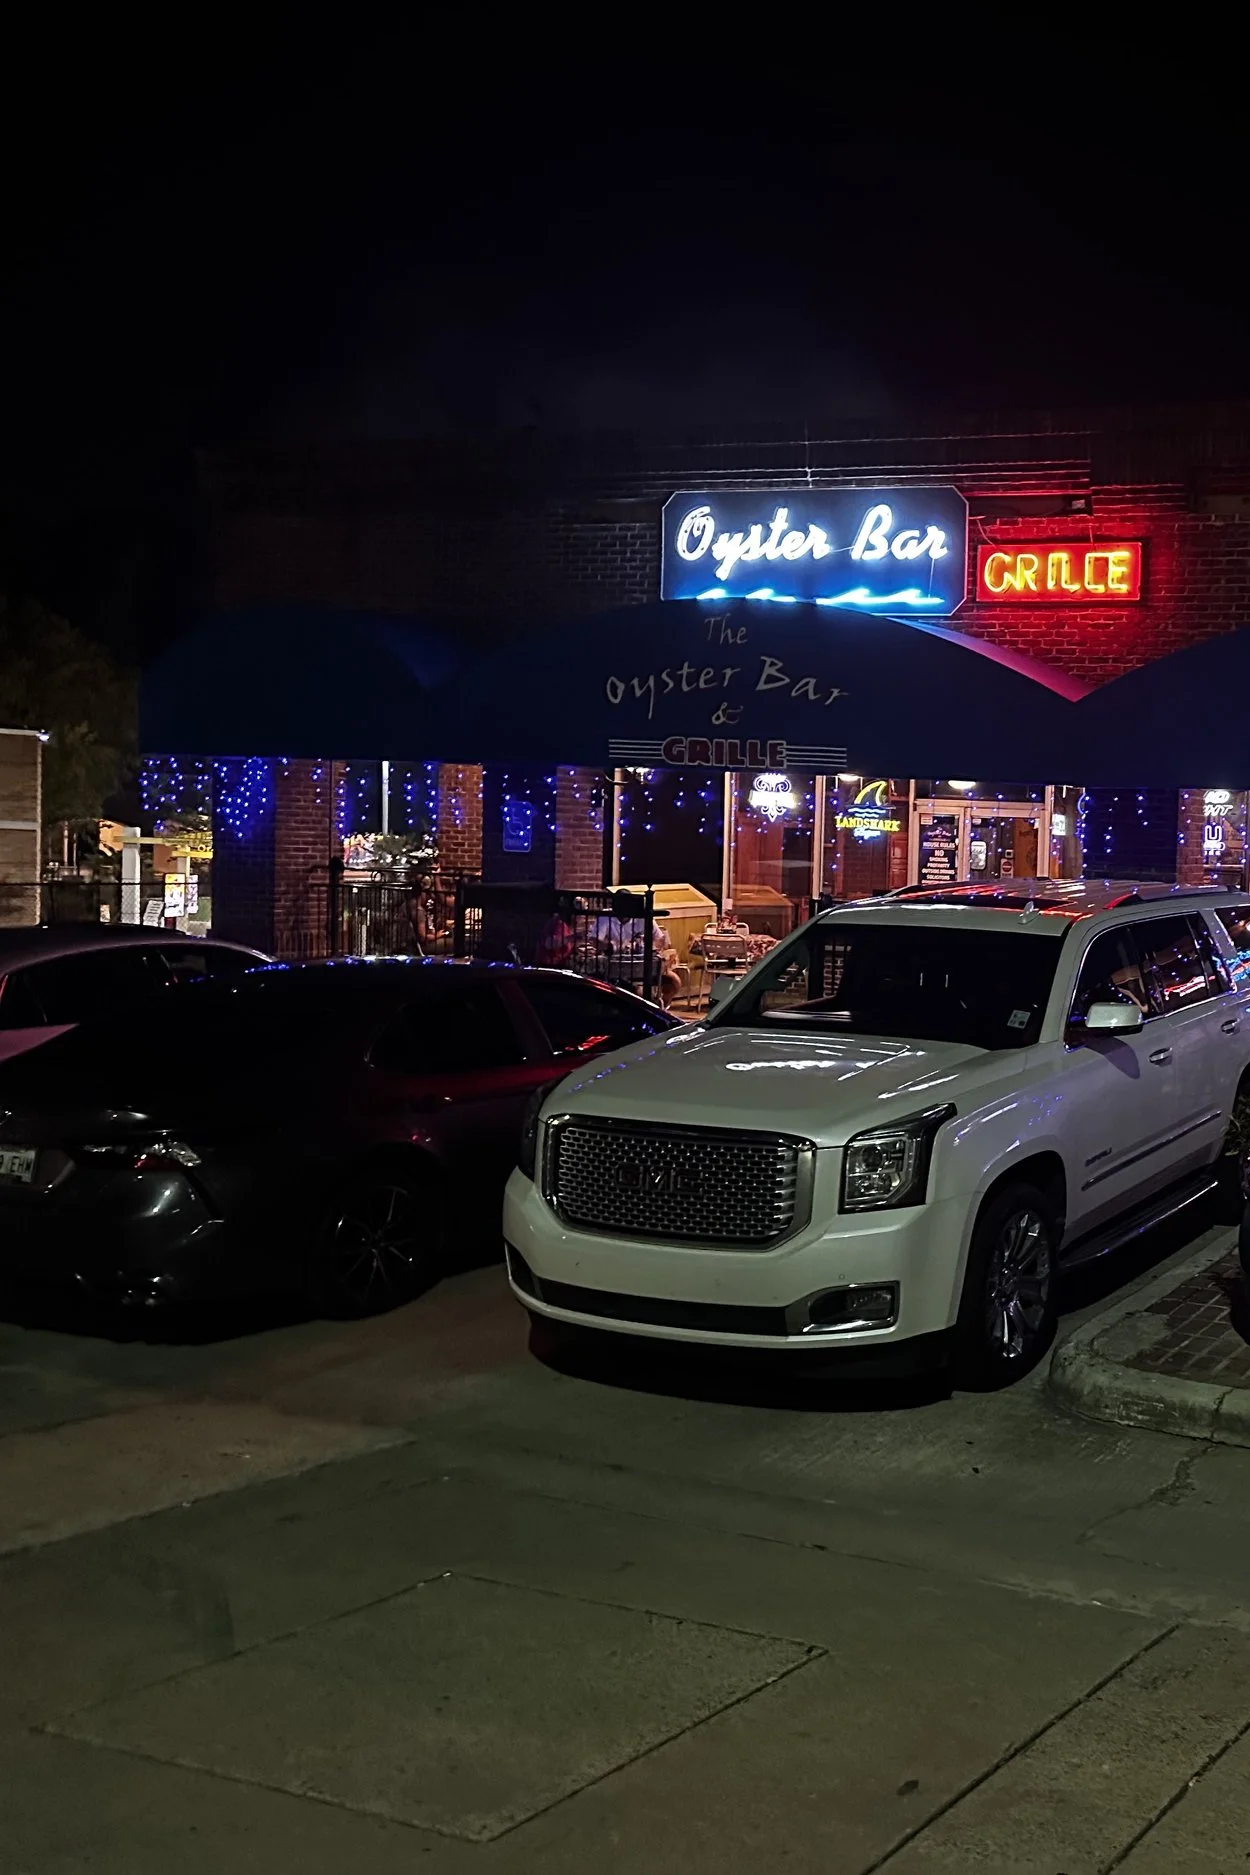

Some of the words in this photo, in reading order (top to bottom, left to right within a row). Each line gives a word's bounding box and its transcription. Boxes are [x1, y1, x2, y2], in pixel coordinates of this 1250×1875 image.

[676, 505, 830, 580] Oyster
[851, 503, 949, 562] Bar
[704, 612, 748, 645] The
[756, 655, 848, 705] Bar
[711, 702, 744, 724] &
[661, 736, 788, 768] GRILLE
[835, 816, 901, 832] LANDSHARK
